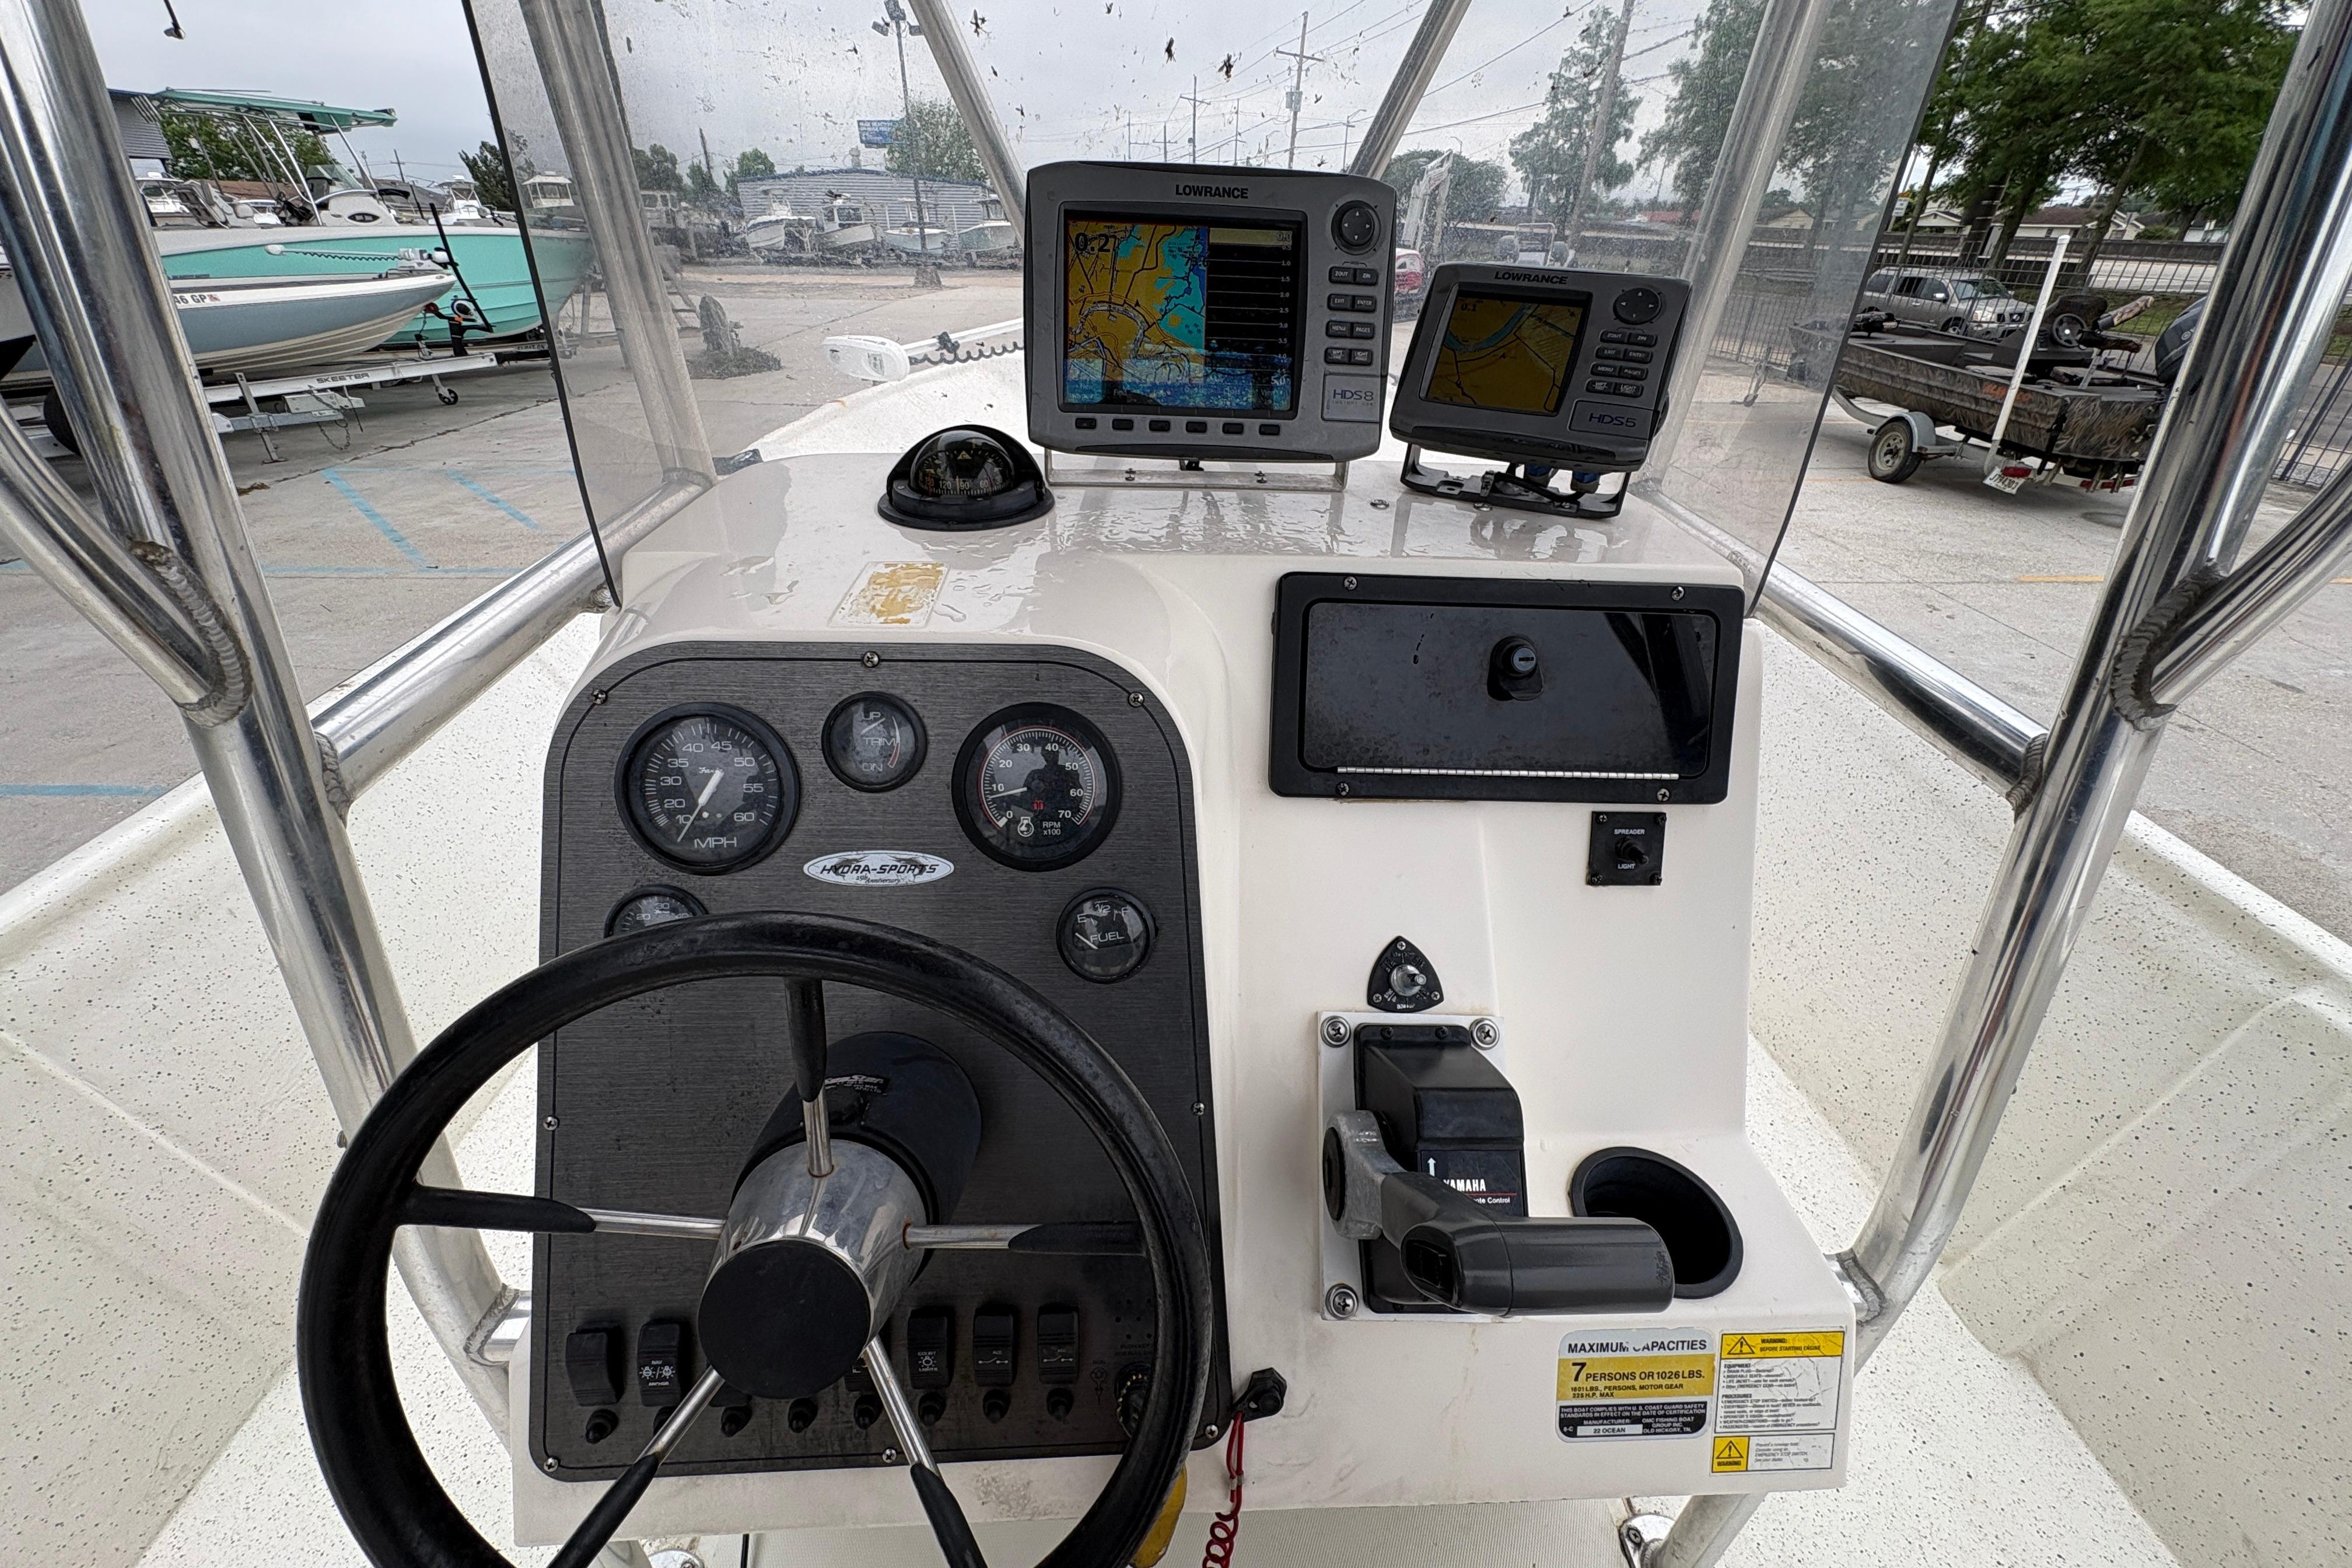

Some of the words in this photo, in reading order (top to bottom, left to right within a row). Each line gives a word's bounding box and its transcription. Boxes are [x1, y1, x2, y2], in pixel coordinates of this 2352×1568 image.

[1175, 184, 1249, 199] LOWRANCE
[1494, 271, 1568, 285] LOWRANCE
[190, 294, 207, 303] GP
[316, 372, 370, 384] SKEETER
[939, 480, 952, 490] 120
[960, 481, 970, 490] 90
[863, 711, 881, 720] UP
[710, 741, 732, 751] 45
[863, 737, 896, 747] TRIM
[682, 743, 704, 752] 40
[1016, 743, 1030, 752] 30
[1045, 743, 1059, 752] 40
[667, 758, 689, 768] 35
[734, 758, 755, 767] 50
[999, 760, 1013, 768] 20
[1065, 762, 1079, 771] 50
[660, 776, 682, 786] 30
[743, 783, 764, 793] 55
[992, 783, 1005, 792] 10
[1070, 789, 1084, 797] 60
[664, 799, 685, 808] 20
[734, 812, 755, 822] 60
[1006, 810, 1013, 819] 0
[1058, 810, 1072, 818] 70
[676, 814, 692, 824] 10
[694, 836, 737, 848] MPH
[820, 864, 940, 874] HYDRA-SPORTS
[1077, 914, 1087, 923] E
[1090, 931, 1125, 943] FUEL
[1572, 1362, 1587, 1382] 7
[1586, 1371, 1637, 1382] PERSONS
[1639, 1371, 1655, 1381] OR
[1657, 1371, 1681, 1380] 1026
[1681, 1369, 1706, 1379] LBS.
